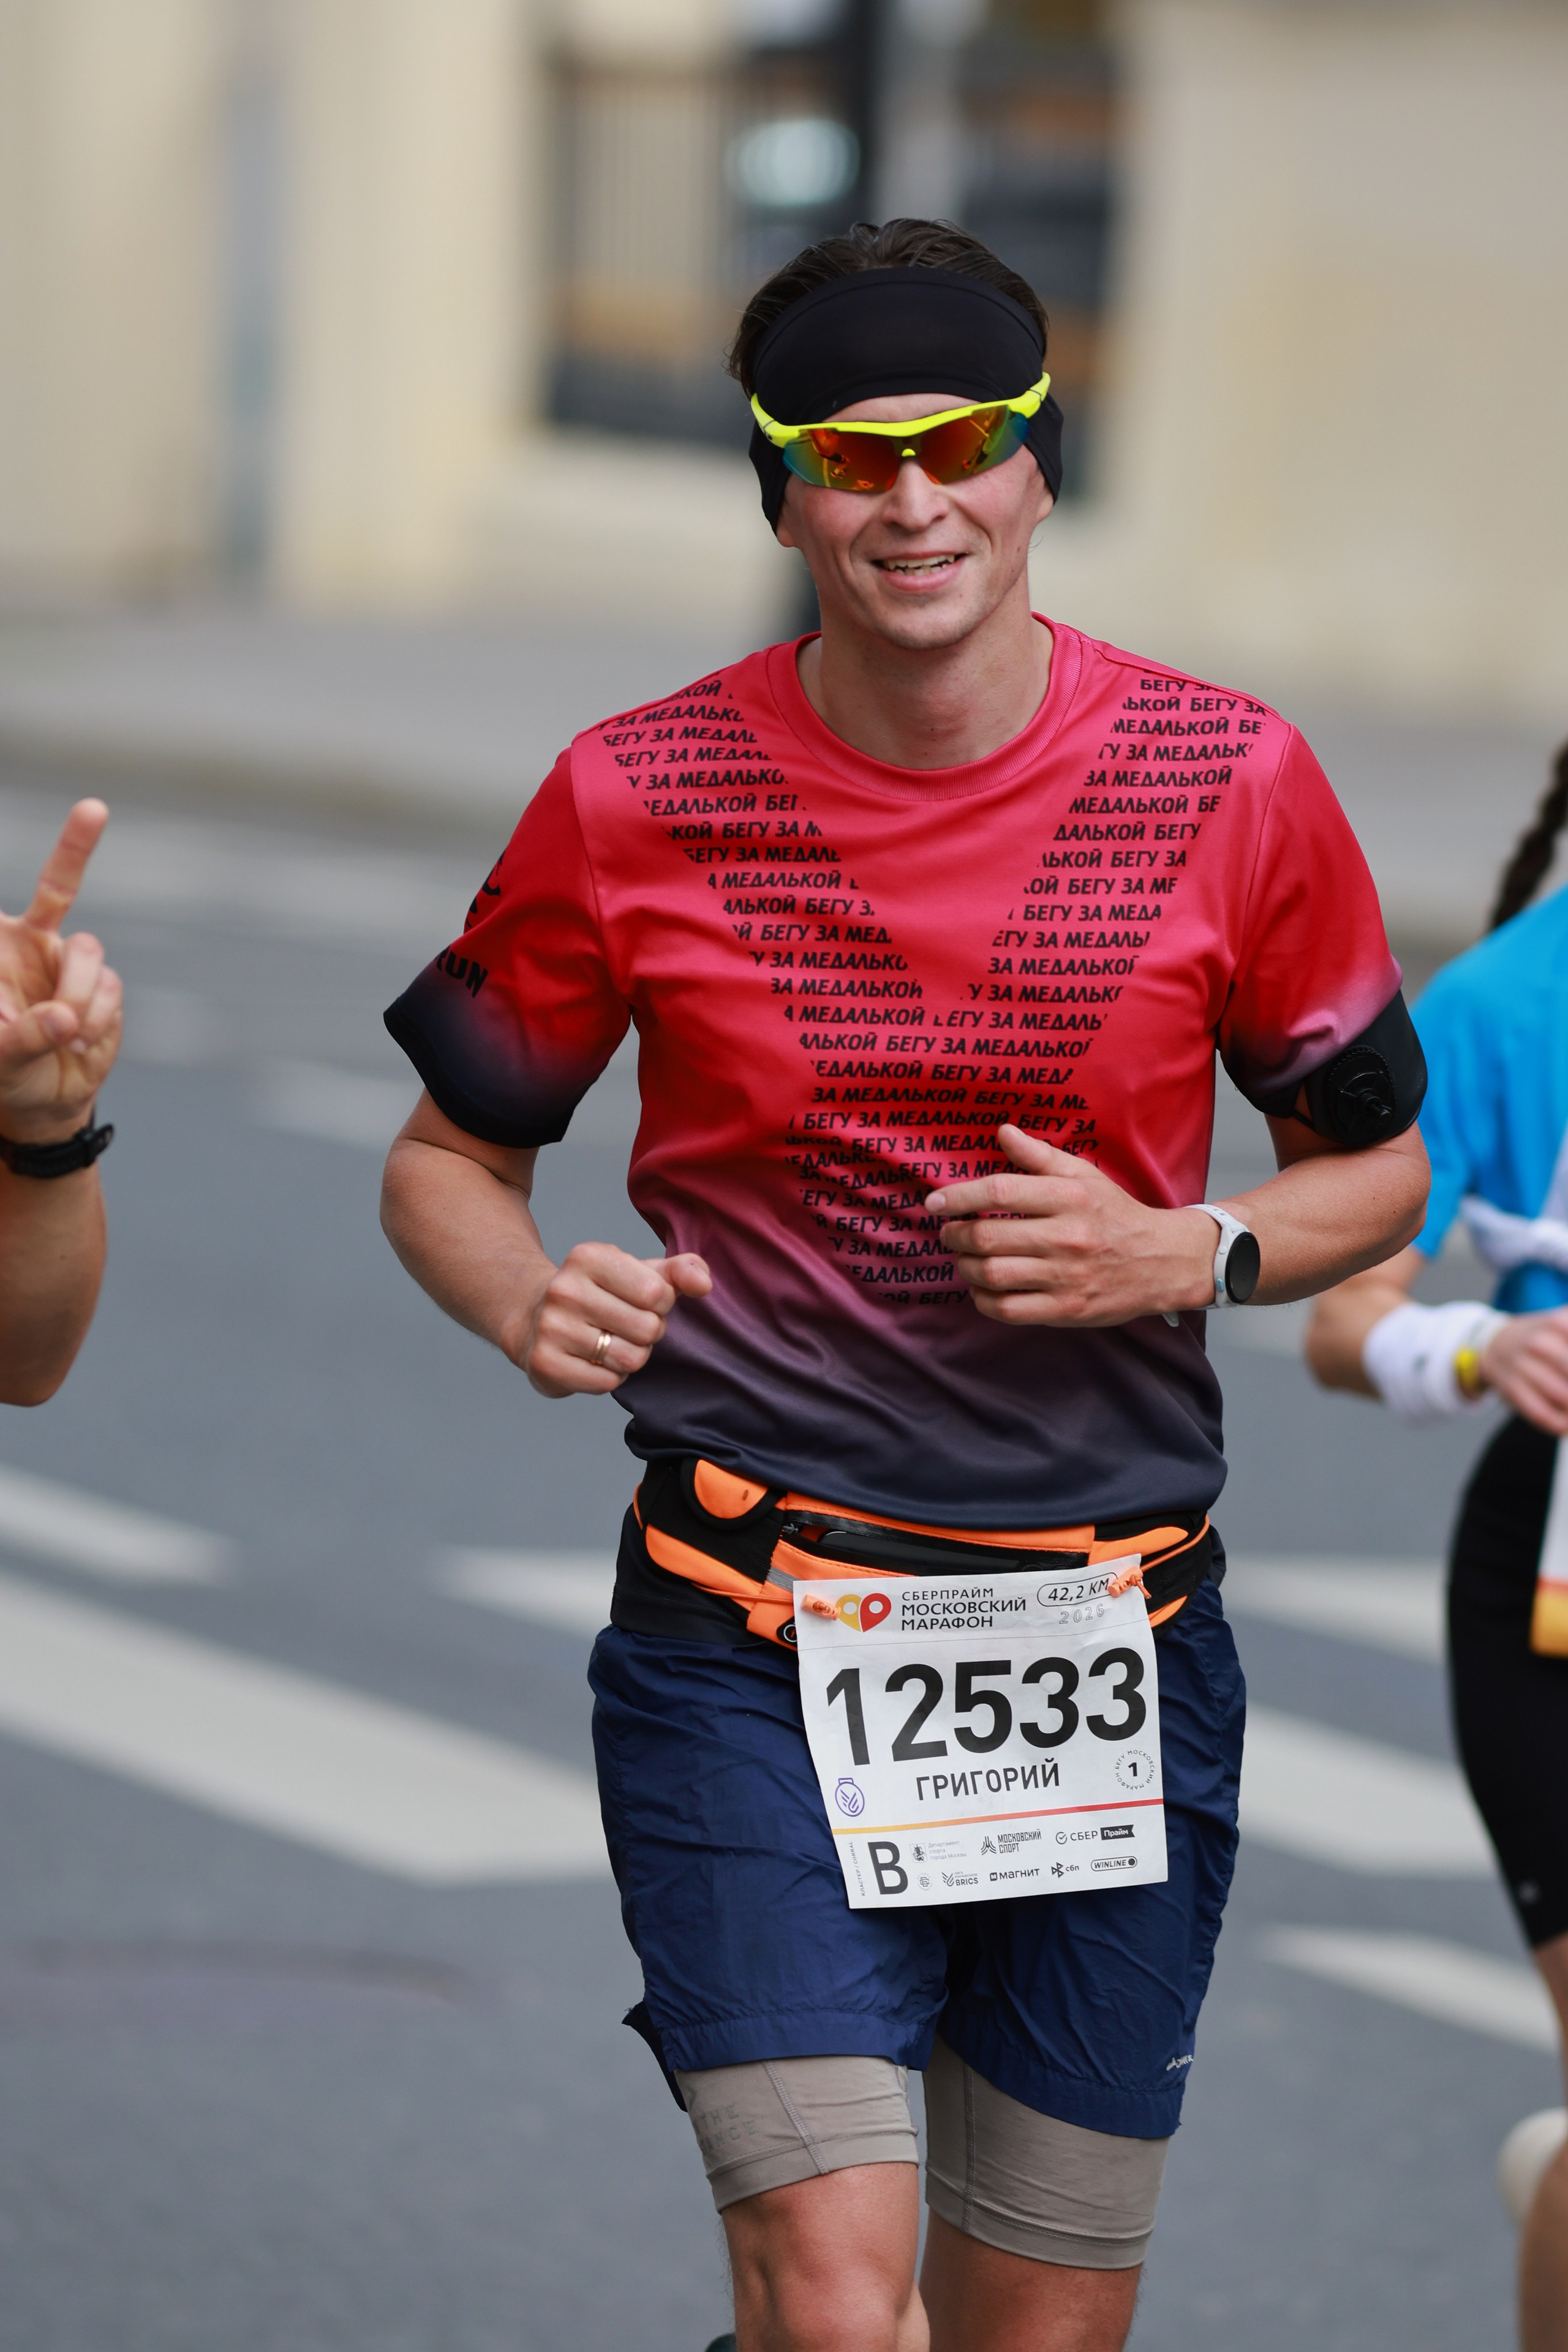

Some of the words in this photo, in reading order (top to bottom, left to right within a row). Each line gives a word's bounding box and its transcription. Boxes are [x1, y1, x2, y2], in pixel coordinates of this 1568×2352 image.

[1140, 679, 1186, 692] БЕГУ
[1190, 697, 1237, 712] БЕГУ
[1243, 701, 1267, 716] ЗА
[650, 728, 674, 742] ЗА
[1114, 717, 1229, 736] МЕДАЛЬКОЙ
[665, 748, 688, 763] ЗА
[1126, 744, 1147, 761] ЗА
[1153, 743, 1253, 761] МЕДАЛЬК
[646, 774, 670, 790] ЗА
[676, 769, 788, 788] МЕДАЛЬКО
[1084, 771, 1106, 786] ЗА
[1112, 766, 1232, 786] МЕДАЛЬКОЙ
[644, 793, 756, 816] ЕДАЛЬКОЙ
[1069, 795, 1188, 813] МЕДАЛЬКОЙ
[666, 821, 712, 840] КОЙ
[722, 821, 770, 839] БЕГУ
[776, 821, 799, 837] ЗА
[1054, 821, 1145, 840] ДАЛЬКОЙ
[1155, 823, 1200, 840] БЕГУ
[736, 846, 759, 861] ЗА
[1111, 851, 1158, 867] БЕГУ
[1164, 850, 1186, 866] ЗА
[722, 870, 841, 889] МЕДАЛЬКОЙ
[1024, 876, 1058, 894] ОЙ
[1068, 878, 1115, 894] БЕГУ
[1121, 878, 1144, 894] ЗА
[805, 898, 854, 914] БЕГУ
[859, 900, 874, 916] З
[1023, 905, 1072, 921] БЕГУ
[1079, 905, 1102, 921] ЗА
[1108, 905, 1161, 921] МЕДА
[733, 922, 752, 940] Й
[761, 925, 810, 940] БЕГУ
[815, 925, 839, 941] ЗА
[845, 926, 891, 943] МЕД
[1034, 932, 1057, 948] ЗА
[771, 951, 793, 967] ЗА
[988, 957, 1012, 974] ЗА
[772, 978, 792, 994] ЗА
[988, 984, 1012, 1001] ЗА
[799, 1006, 925, 1025] МЕДАЛЬКОЙ
[989, 1012, 1013, 1028] ЗА
[1019, 1013, 1107, 1030] МЕДАЛЬ
[886, 1036, 936, 1052] БЕГУ
[941, 1038, 965, 1054] ЗА
[811, 1060, 922, 1079] ЕДАЛЬКОЙ
[931, 1065, 982, 1081] БЕГУ
[986, 1066, 1011, 1083] ЗА
[812, 1087, 836, 1102] ЗА
[842, 1088, 967, 1102] МЕДАЛЬКОЙ
[974, 1091, 1025, 1106] БЕГУ
[1030, 1094, 1055, 1109] ЗА
[804, 1112, 851, 1129] БЕГУ
[858, 1112, 880, 1128] ЗА
[886, 1110, 1010, 1126] МЕДАЛЬКОЙ
[1017, 1114, 1068, 1132] БЕГУ
[1072, 1119, 1096, 1134] ЗА
[851, 1137, 897, 1153] БЕГУ
[904, 1136, 925, 1152] ЗА
[949, 1161, 968, 1177] ЗА
[800, 1189, 837, 1206] ЕГУ
[837, 1216, 883, 1232] БЕГУ
[889, 1216, 913, 1231] ЗА
[848, 1238, 871, 1255] ЗА
[846, 1262, 954, 1283] ЕДАЛЬКОЙ
[919, 1289, 968, 1305] БЕГУ
[902, 1587, 993, 1601] СБЕРПРАЙМ
[1048, 1585, 1084, 1602] 42,2
[902, 1599, 1026, 1616] МОСКОВСКИЙ
[1058, 1603, 1105, 1624] 2026
[902, 1616, 993, 1630] МАРАФОН
[826, 1648, 1147, 1766] 12533
[1128, 1762, 1137, 1777] 1
[916, 1758, 1060, 1801] ГРИГОРИЙ
[998, 1828, 1041, 1843] МОСКОВСКИЙ
[1070, 1830, 1098, 1841] СБЕР
[1104, 1828, 1128, 1838] Прайм
[849, 1841, 858, 1864] CORRAL
[999, 1843, 1019, 1853] СПОРТ
[1094, 1860, 1126, 1869] WINLINE
[856, 1869, 865, 1896] КЛАСТЕР
[956, 1877, 978, 1886] BRICS
